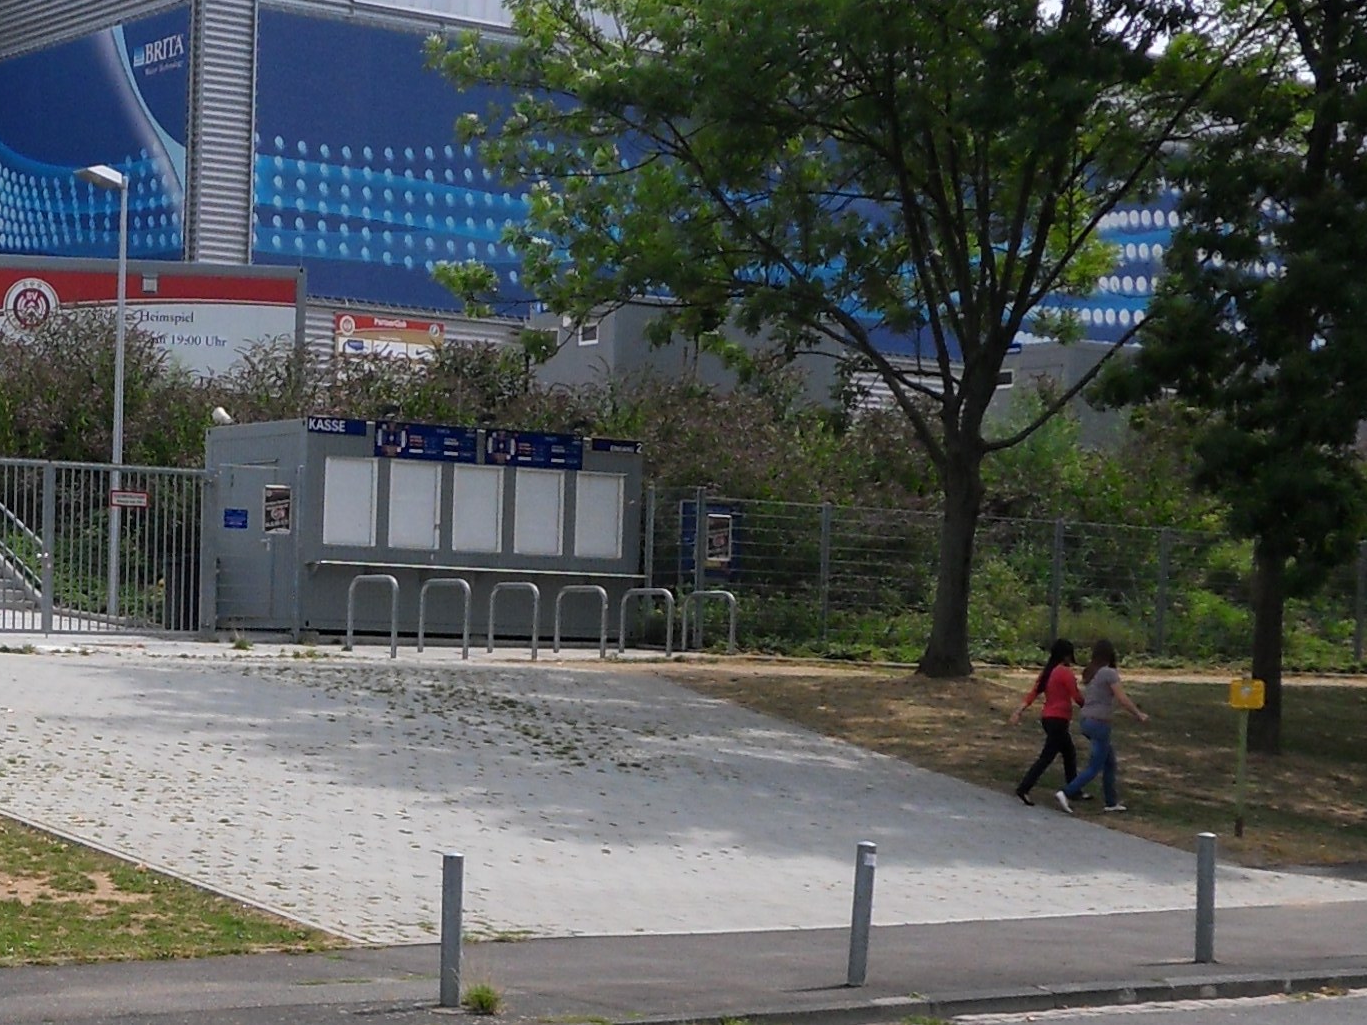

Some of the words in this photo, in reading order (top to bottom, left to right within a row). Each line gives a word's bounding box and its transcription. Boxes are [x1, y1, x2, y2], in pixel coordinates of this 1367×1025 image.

[144, 34, 184, 64] BRITA
[140, 310, 194, 325] Heimspiel
[171, 335, 202, 346] 19:00
[205, 335, 228, 347] Uhr
[308, 418, 346, 432] KASSE
